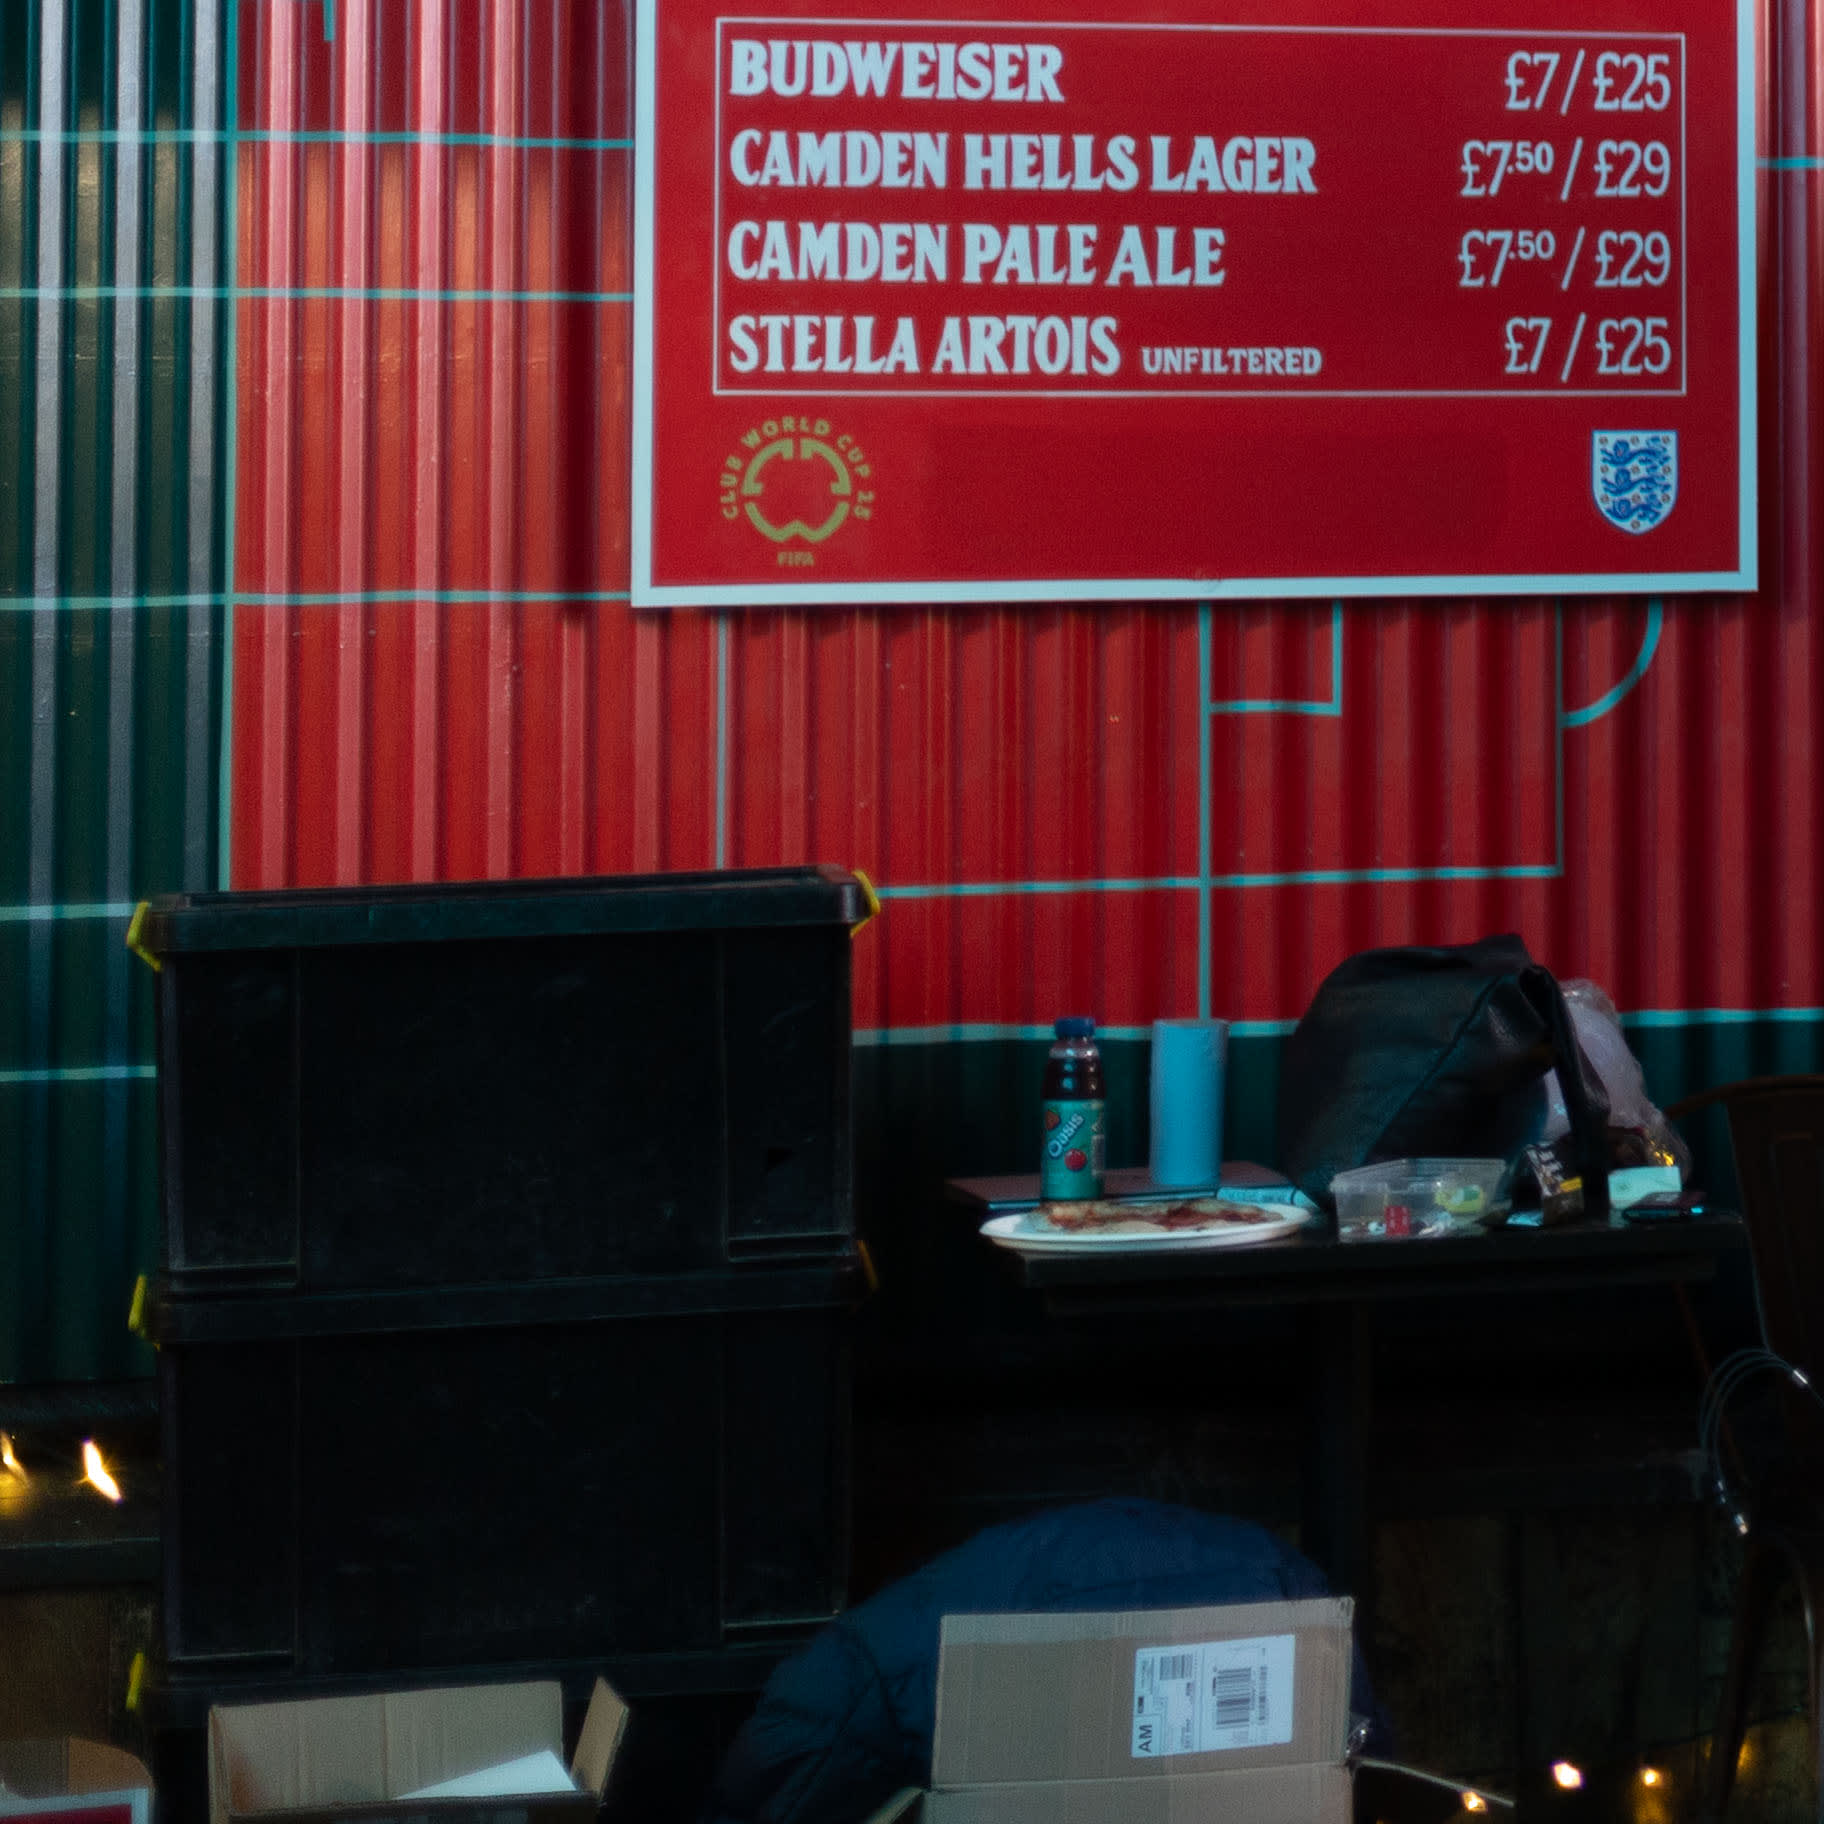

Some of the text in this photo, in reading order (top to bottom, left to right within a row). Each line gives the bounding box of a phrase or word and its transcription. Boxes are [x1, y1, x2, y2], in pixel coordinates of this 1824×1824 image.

[729, 40, 1065, 103] BUDWEISER
[729, 129, 1318, 193] CAMDEN HELLS LAGER
[727, 221, 1225, 287] CAMDEN PALE ALE
[728, 315, 1322, 376] STELLA ARTOIS UNFILTERED
[720, 455, 743, 520] CLUB
[740, 415, 831, 448] WORLD
[837, 434, 871, 478] CUP
[1048, 1113, 1085, 1158] Oasis
[1138, 1723, 1153, 1754] AM
